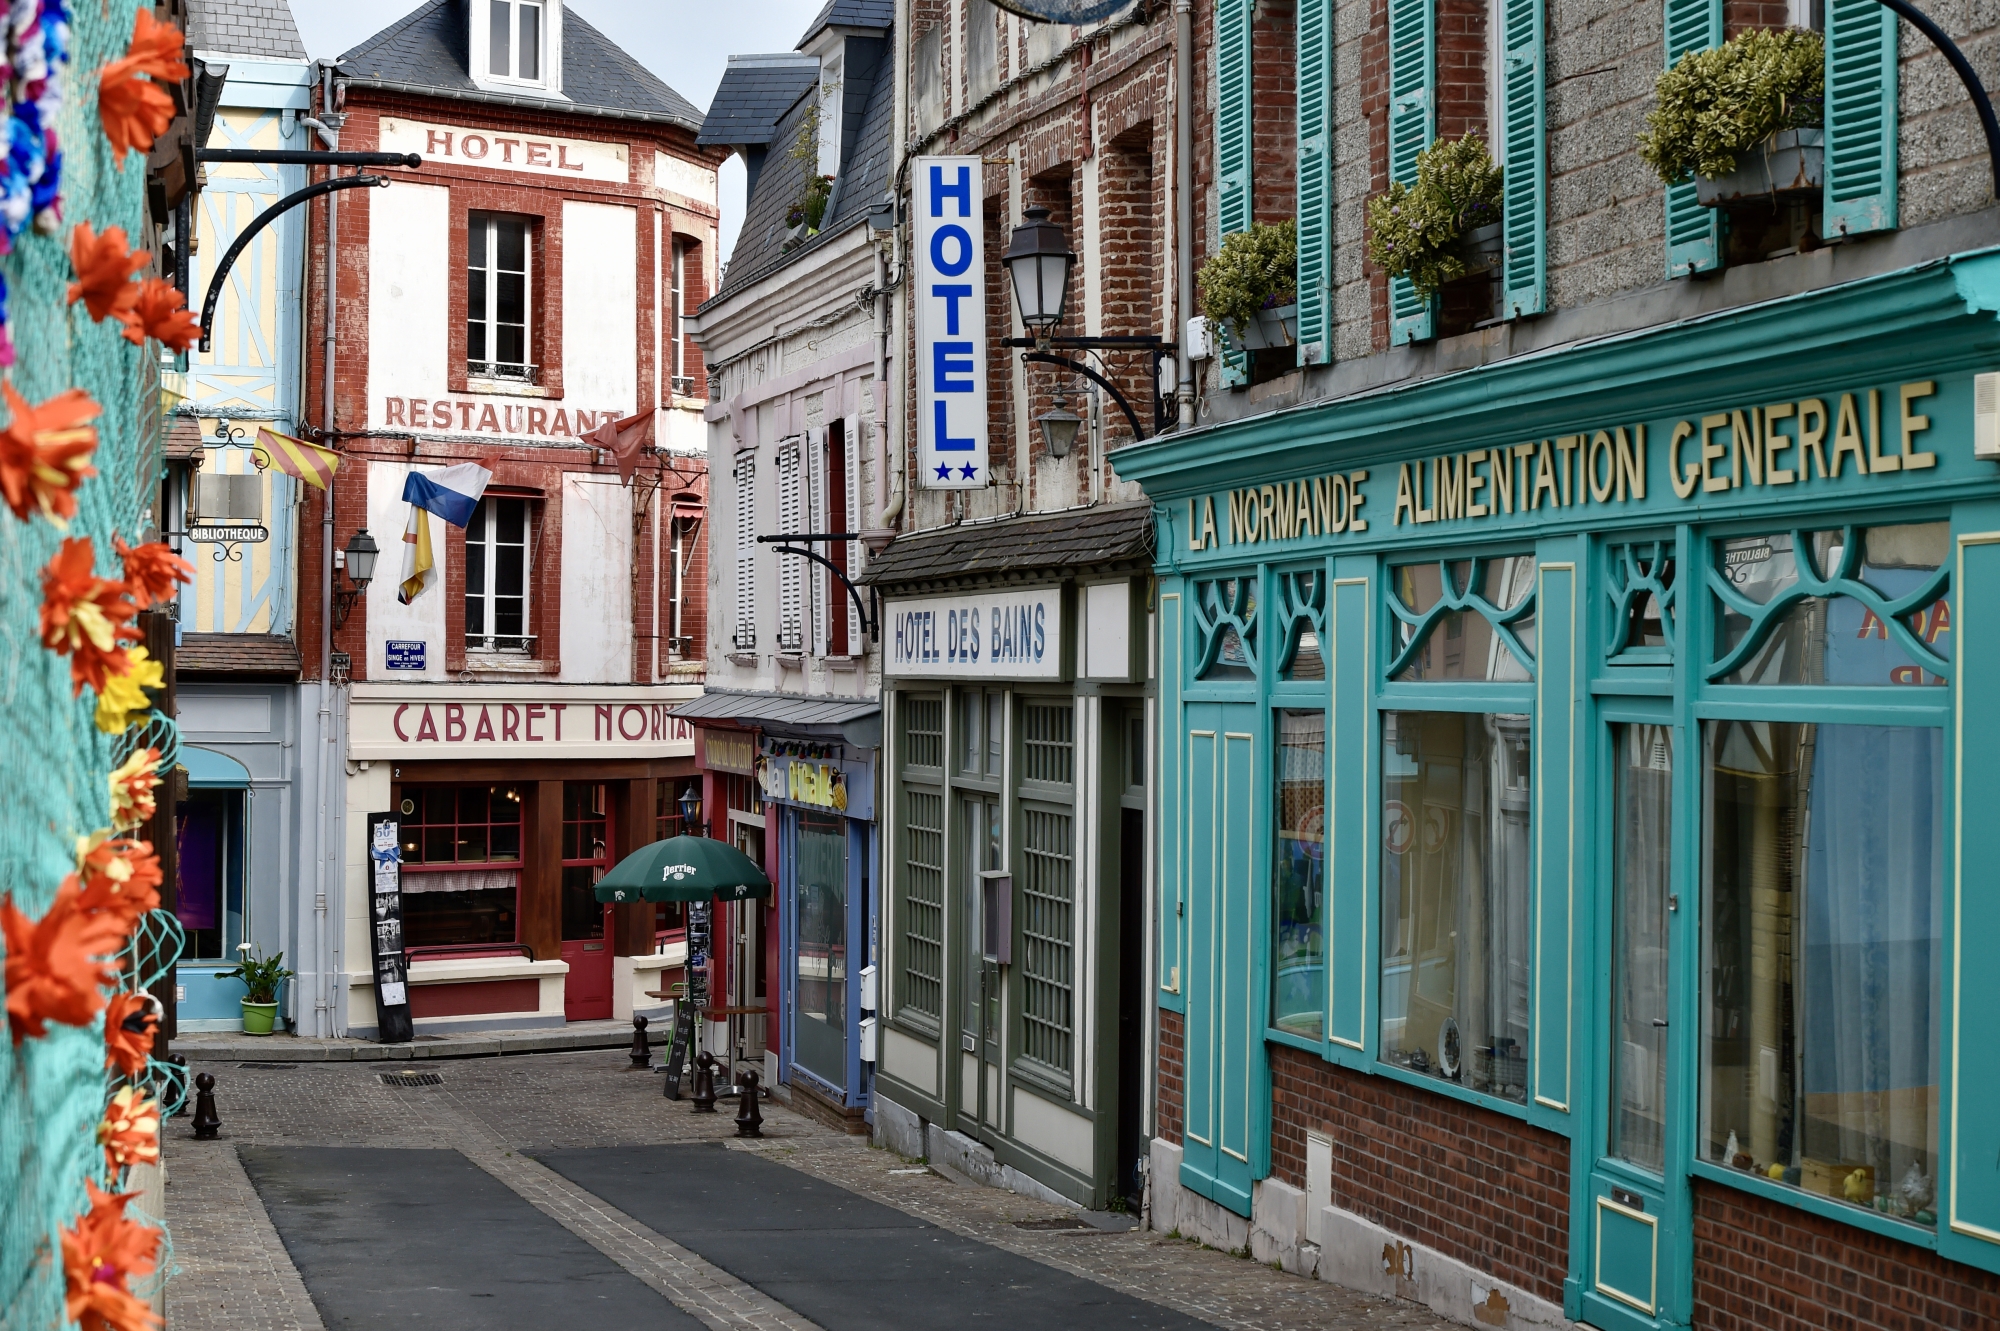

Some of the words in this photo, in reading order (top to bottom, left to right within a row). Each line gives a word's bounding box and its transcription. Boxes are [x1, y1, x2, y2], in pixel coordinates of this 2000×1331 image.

[426, 129, 583, 171] HOTEL
[929, 166, 975, 451] HOTEL
[1189, 496, 1218, 550] LA
[1228, 470, 1369, 545] NORMANDE
[1393, 423, 1646, 526] ALIMENTATION
[1668, 380, 1936, 499] GENERALE
[192, 528, 264, 540] BIBLIOTHEQUE
[895, 611, 940, 664] HOTEL
[948, 607, 980, 664] DES
[991, 602, 1045, 664] BAINS
[394, 703, 566, 742] CABARET
[395, 768, 400, 778] 2
